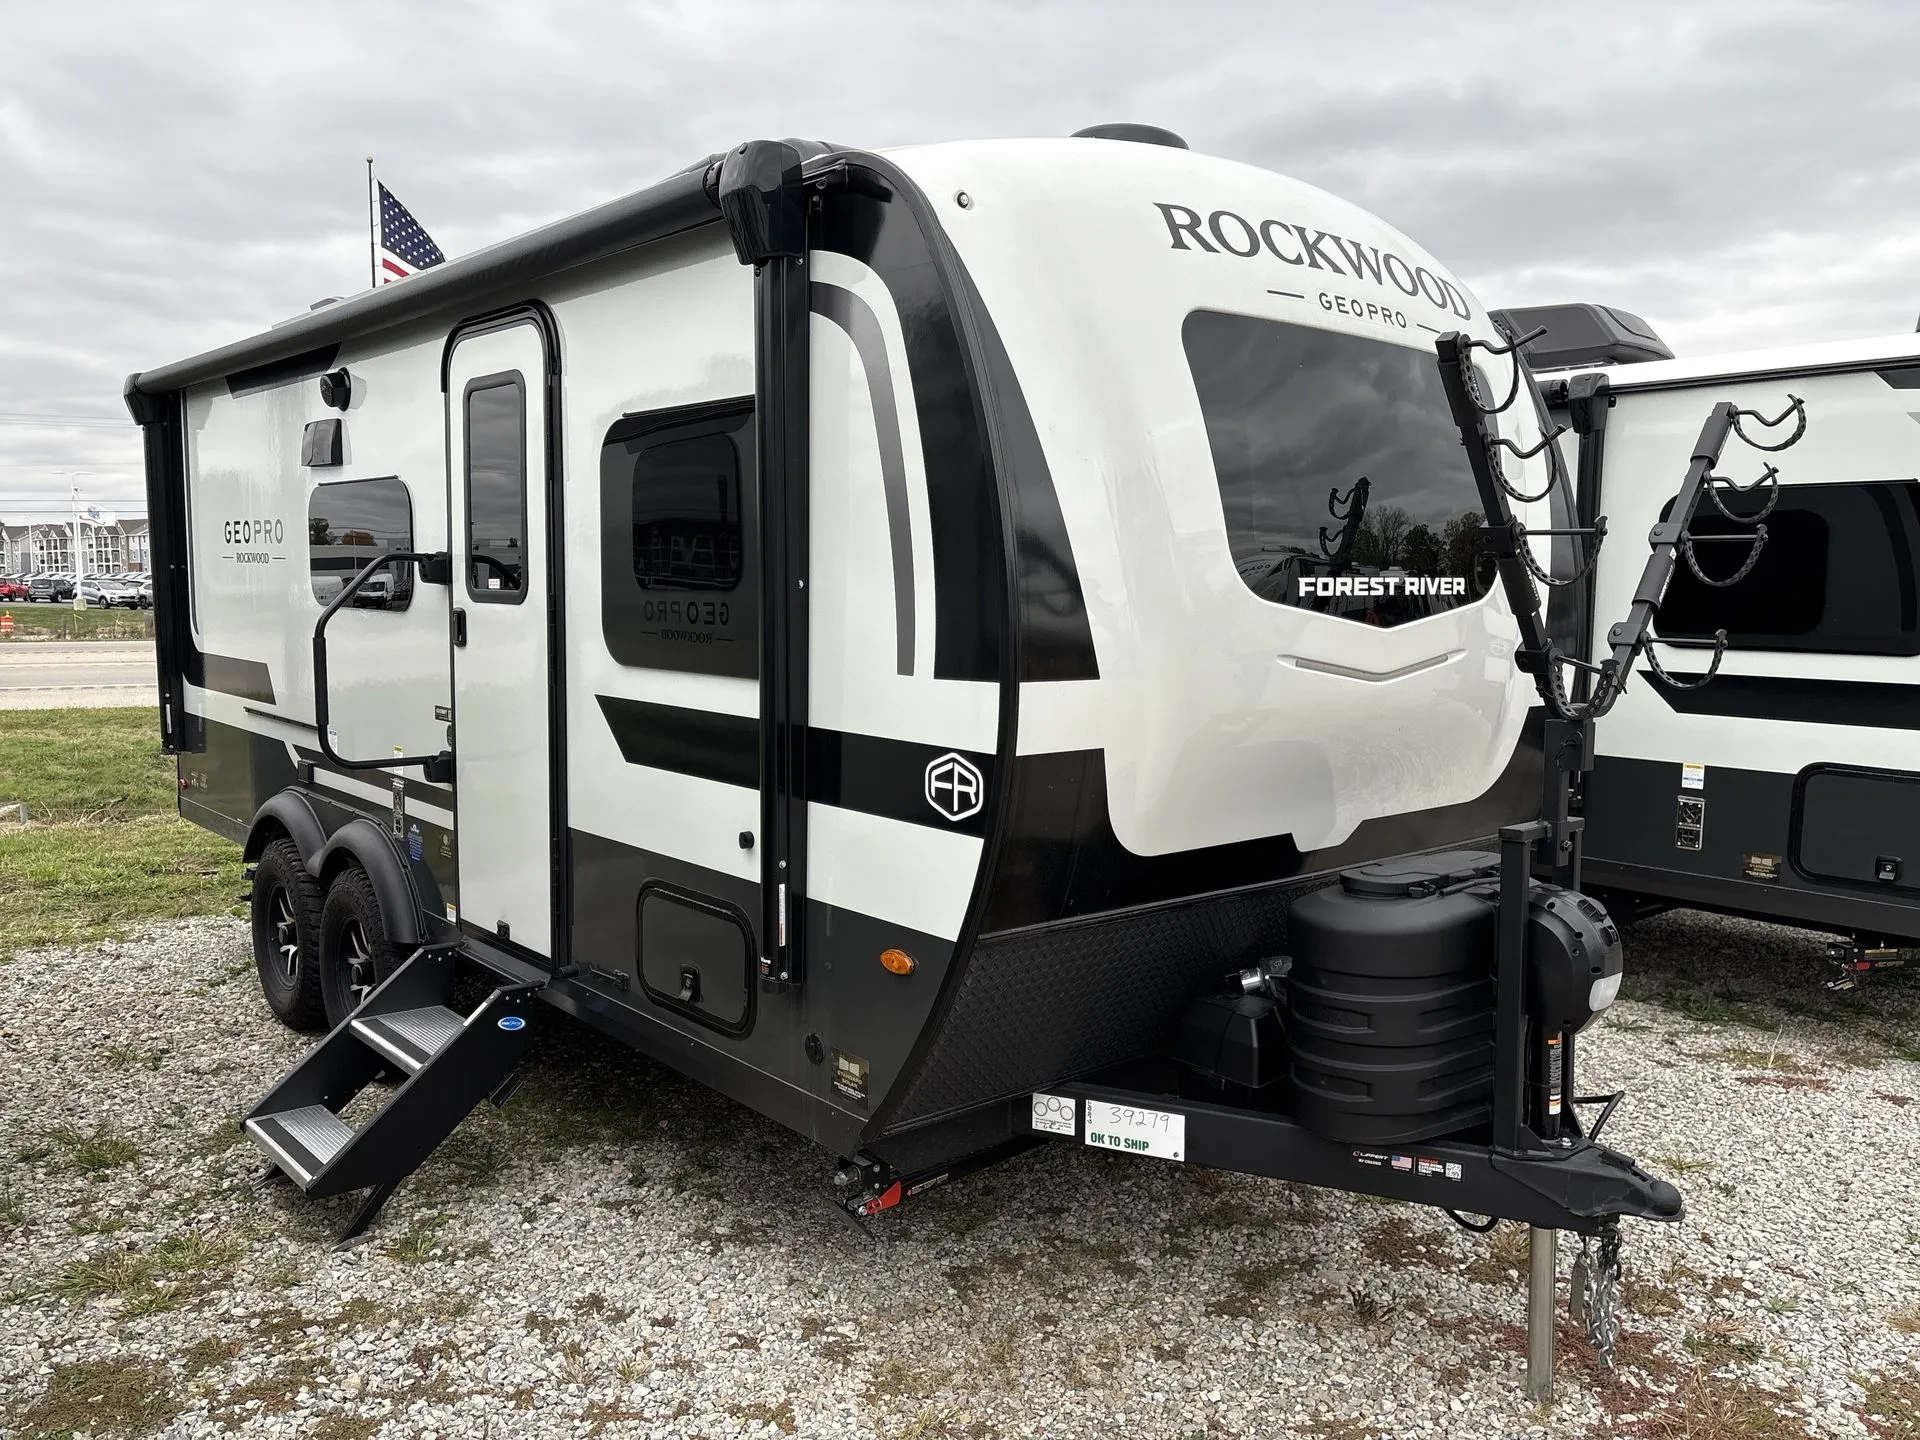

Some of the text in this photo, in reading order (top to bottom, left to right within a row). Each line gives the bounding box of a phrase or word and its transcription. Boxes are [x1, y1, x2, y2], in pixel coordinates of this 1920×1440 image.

[1152, 202, 1471, 321] ROCKWOOD
[1318, 292, 1407, 328] GEOPRO
[224, 519, 284, 544] GEOPRO
[236, 552, 270, 564] ROCKWOOD
[1298, 577, 1466, 597] FOREST RIVER
[1109, 1106, 1170, 1133] 39279
[1090, 1131, 1150, 1152] OK TO SHIP
